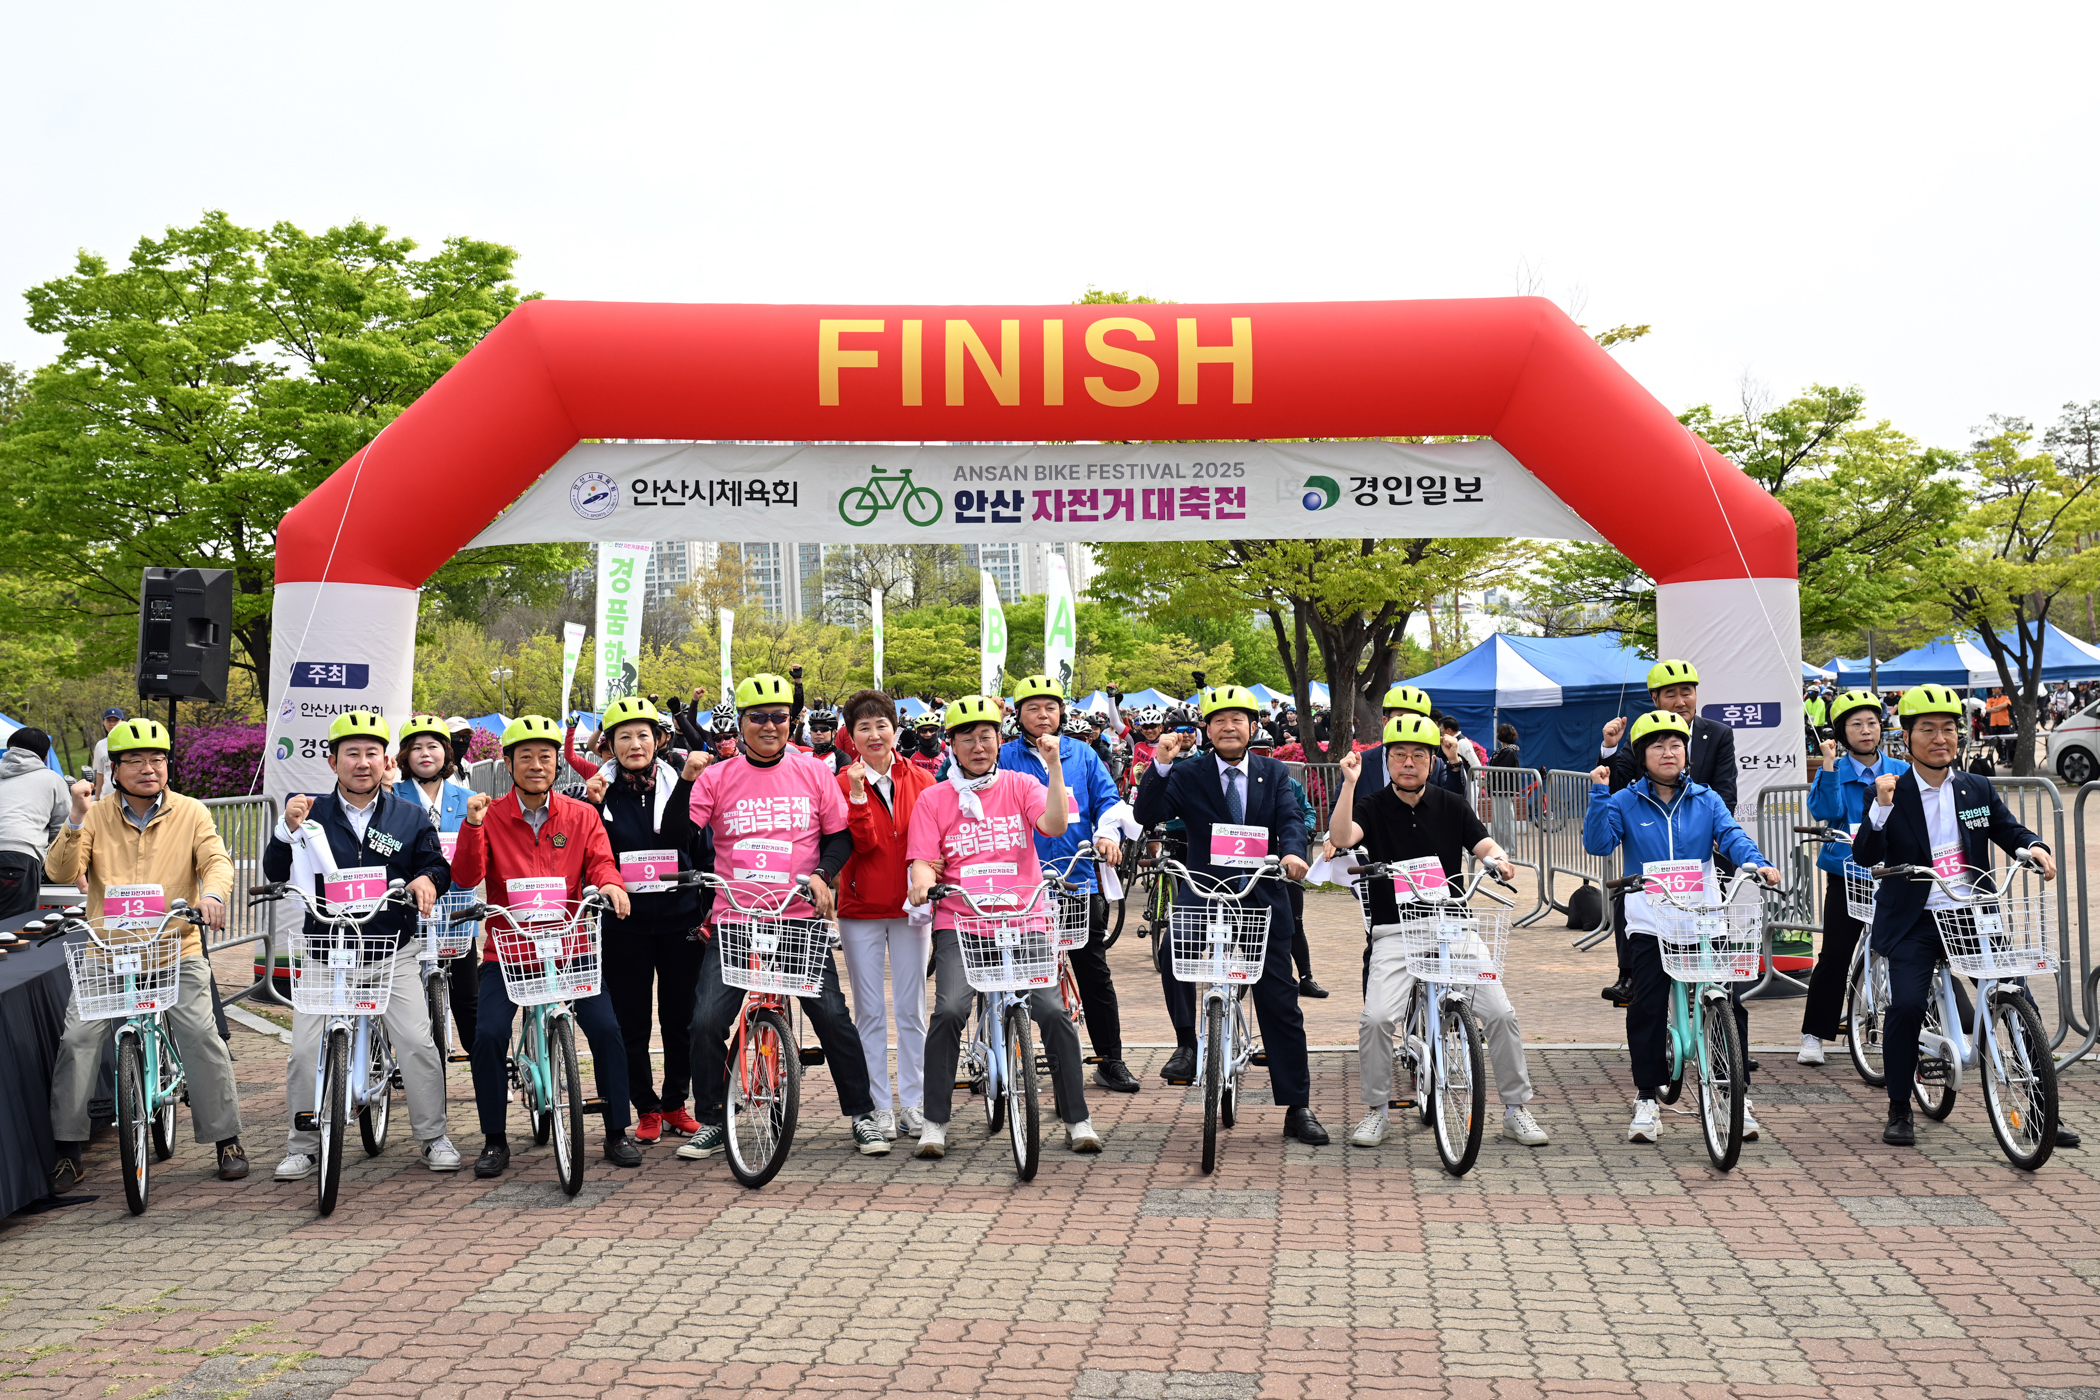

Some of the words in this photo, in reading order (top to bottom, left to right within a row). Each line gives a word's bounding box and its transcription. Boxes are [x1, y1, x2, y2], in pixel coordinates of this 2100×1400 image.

[819, 317, 1253, 407] FINISH
[953, 465, 1028, 481] ANSAN
[1034, 464, 1080, 481] BIKE
[1086, 463, 1186, 480] FESTIVAL
[1192, 462, 1245, 478] 2025
[631, 478, 798, 508] 안산시체육회
[1350, 475, 1483, 506] 경인일보
[954, 489, 1024, 523] 안산
[1031, 486, 1246, 522] 자전거대축전
[604, 557, 634, 678] 경품함
[1047, 596, 1073, 648] A
[987, 608, 1004, 653] B
[308, 664, 347, 686] 주최
[1723, 704, 1762, 726] 후원
[1739, 754, 1797, 770] 안산시
[736, 796, 811, 816] 안산국제
[1958, 805, 1991, 820] 국회의원
[723, 813, 811, 836] 거리극축제
[958, 813, 1026, 840] 안산국제
[367, 826, 404, 853] 경기도의원
[945, 831, 1027, 857] 거리극축제
[1234, 839, 1246, 855] 2
[644, 864, 655, 879] 9
[755, 853, 767, 869] 3
[1938, 857, 1961, 875] 15
[345, 883, 366, 900] 11
[985, 877, 993, 892] 1
[1663, 874, 1686, 891] 16
[121, 899, 145, 916] 13
[532, 892, 544, 908] 4
